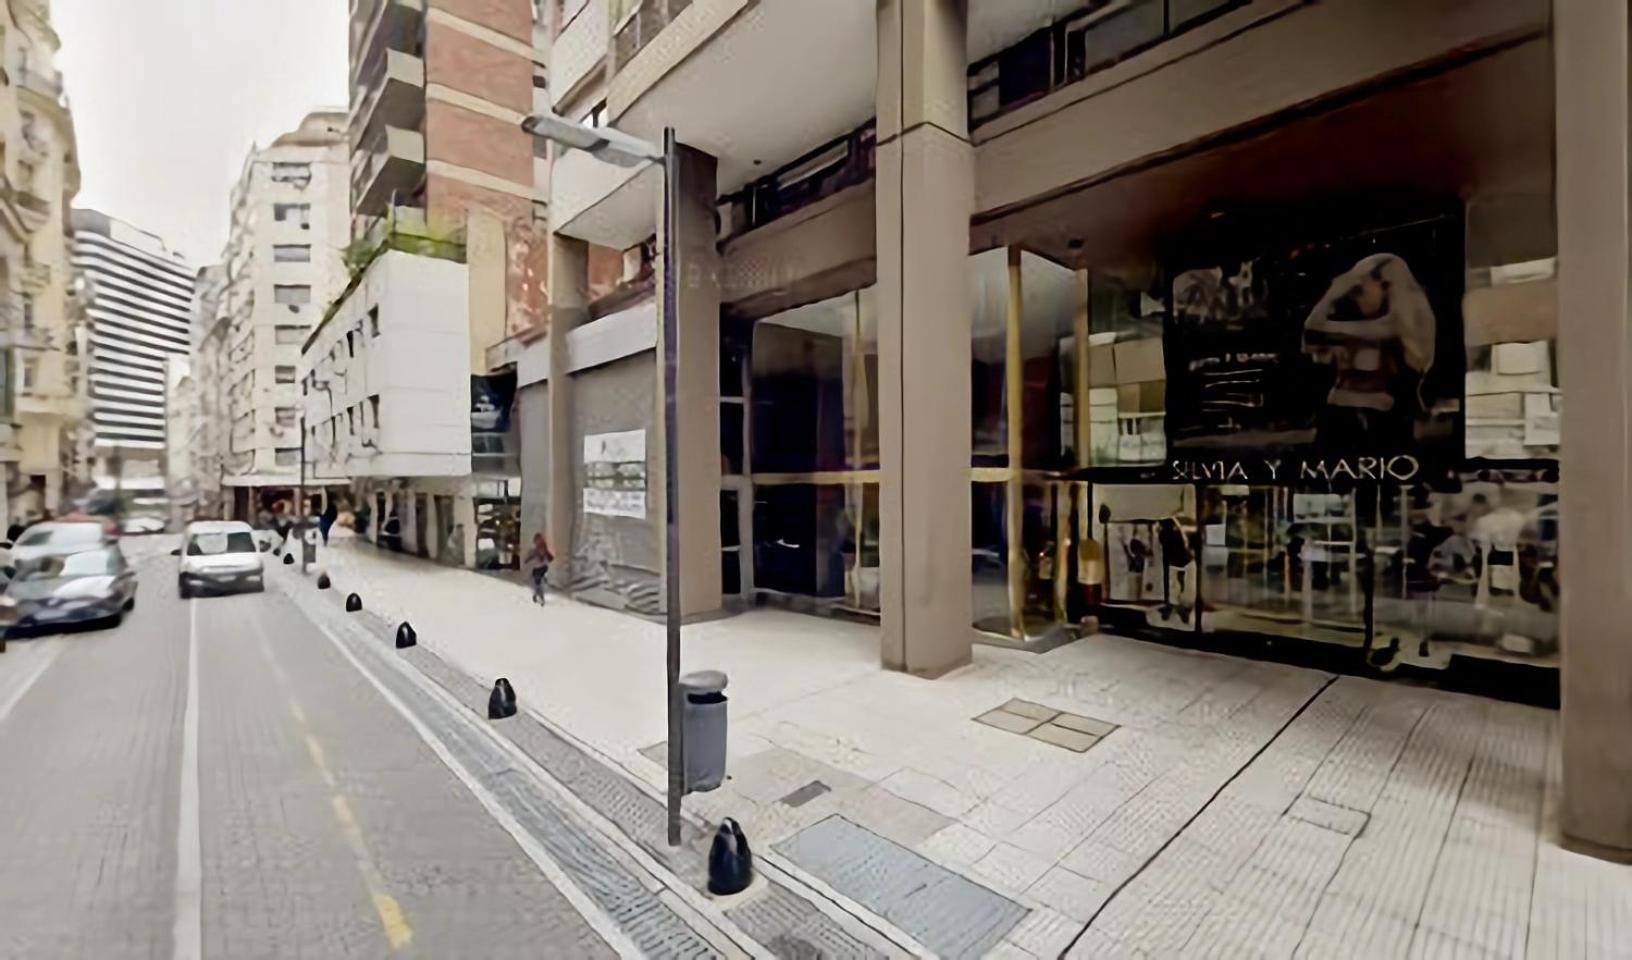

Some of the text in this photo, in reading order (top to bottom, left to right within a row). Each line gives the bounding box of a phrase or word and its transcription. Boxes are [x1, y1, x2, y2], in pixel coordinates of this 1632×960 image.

[1172, 454, 1420, 481] SILVIA Y MARIO
